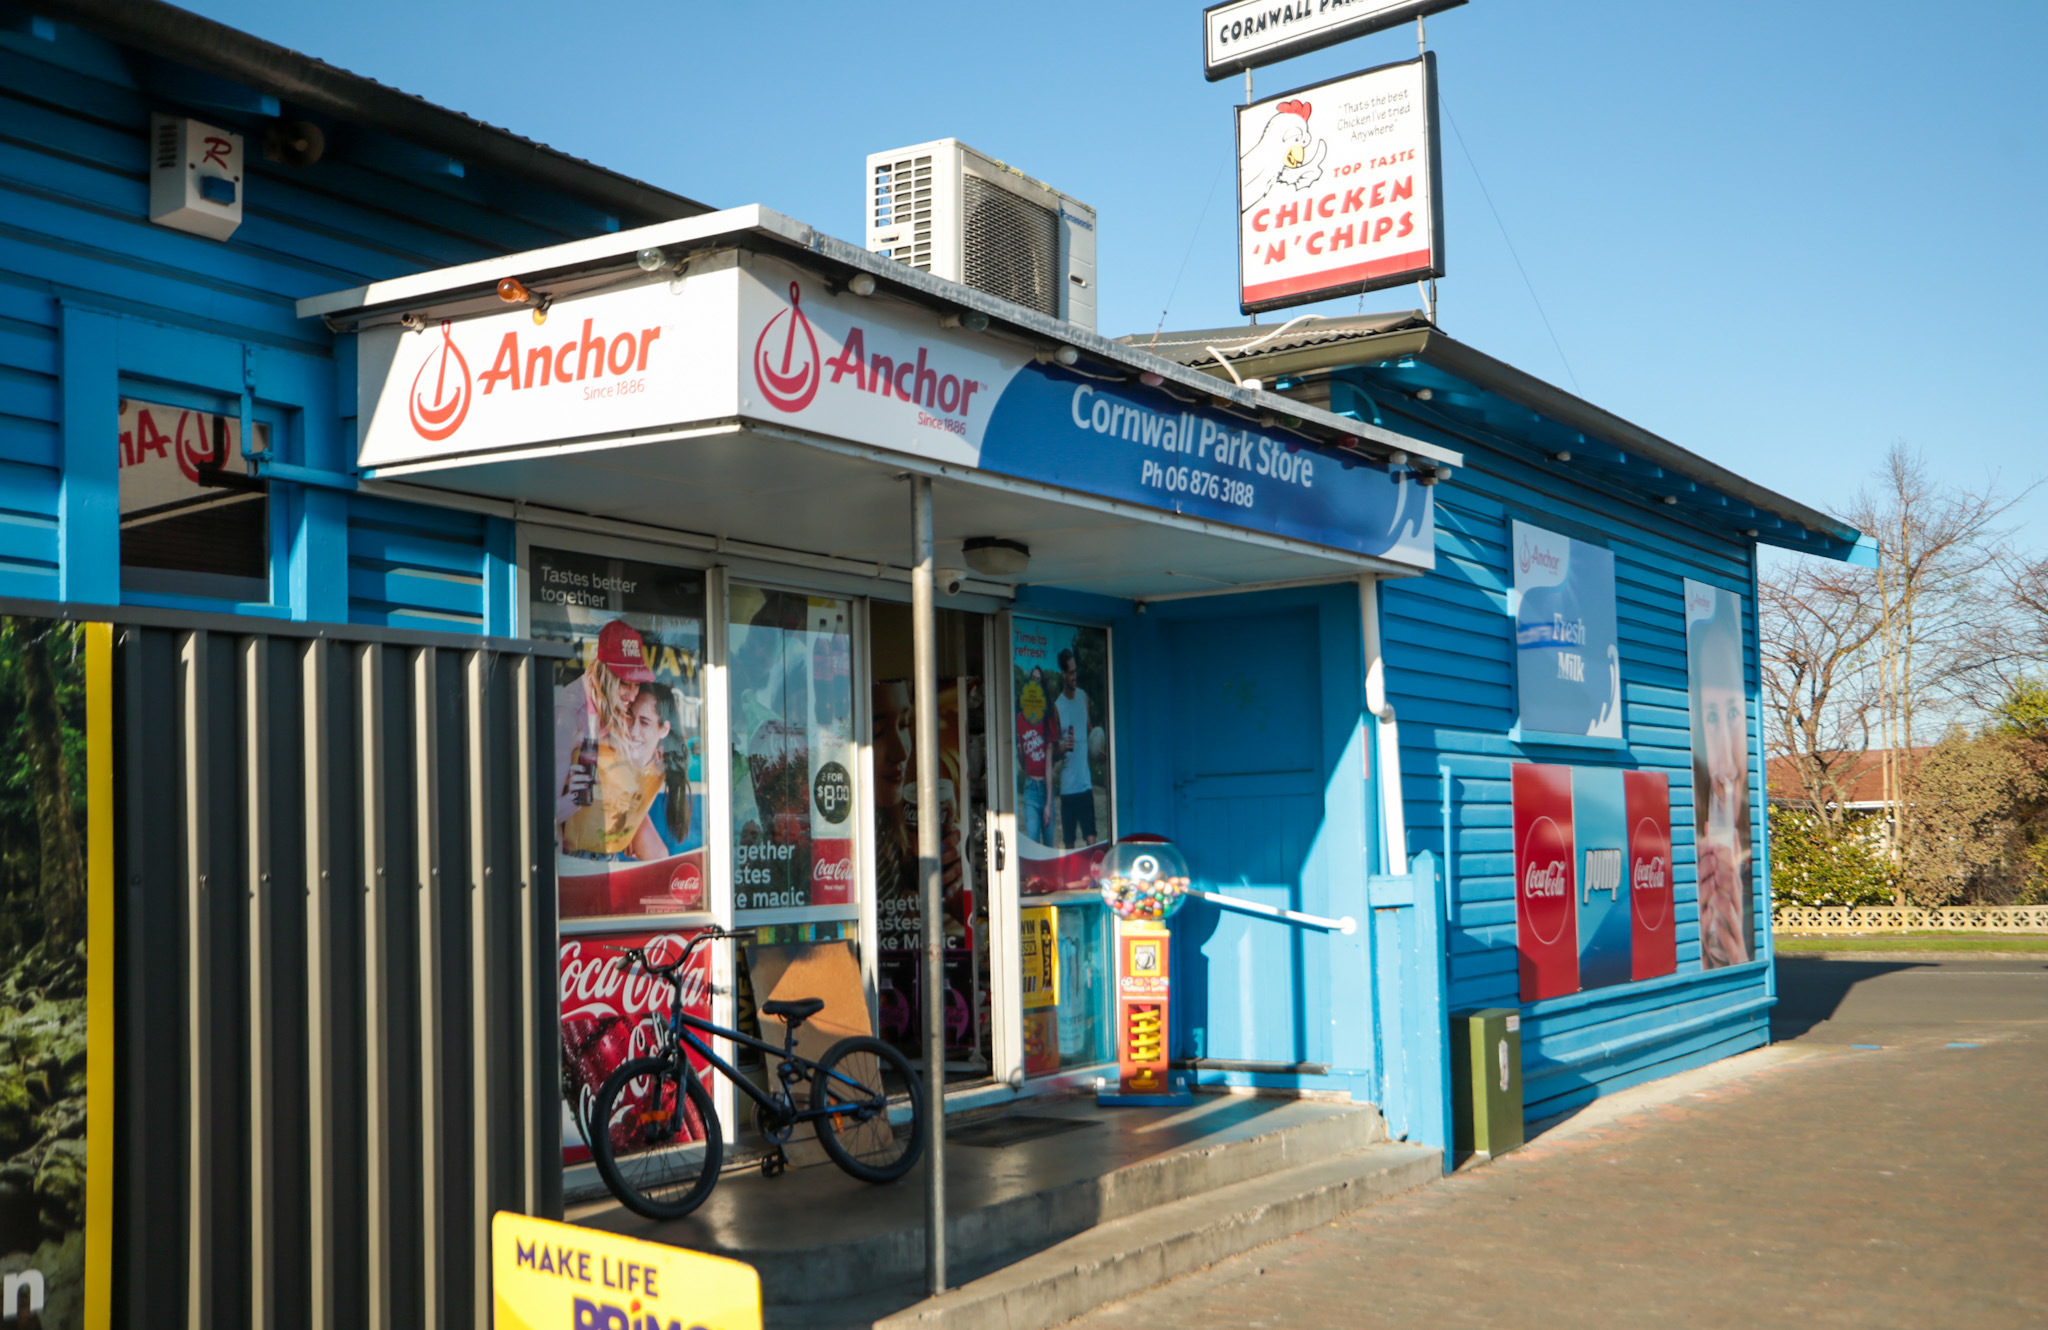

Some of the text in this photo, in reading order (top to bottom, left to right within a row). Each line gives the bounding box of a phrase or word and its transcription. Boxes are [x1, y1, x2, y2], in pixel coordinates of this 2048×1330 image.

[1220, 0, 1312, 43] CORNWALL
[1371, 95, 1386, 107] the
[1387, 89, 1408, 103] best
[1337, 114, 1371, 131] Chicken
[1388, 101, 1411, 117] tried
[1333, 148, 1415, 178] TOP TASTE
[1251, 175, 1413, 233] CHICKEN
[477, 317, 662, 396] Anchor
[824, 326, 980, 417] Anchor
[583, 378, 646, 401] Since 1886
[917, 411, 967, 436] Since 1886
[1071, 383, 1314, 488] Cornwall Park Store
[1141, 459, 1255, 508] Ph 06 876 3188
[1531, 544, 1561, 572] Anchor
[541, 566, 638, 594] Tastes better
[540, 586, 606, 608] together
[1015, 630, 1047, 646] Time to
[1552, 612, 1586, 646] Fresh
[1015, 645, 1046, 659] refresh
[1557, 651, 1586, 684] Milk
[827, 772, 843, 783] FOR
[738, 841, 796, 867] gether
[1583, 848, 1622, 904] pump
[753, 886, 805, 907] magic
[515, 1236, 659, 1298] MAKE LIFE
